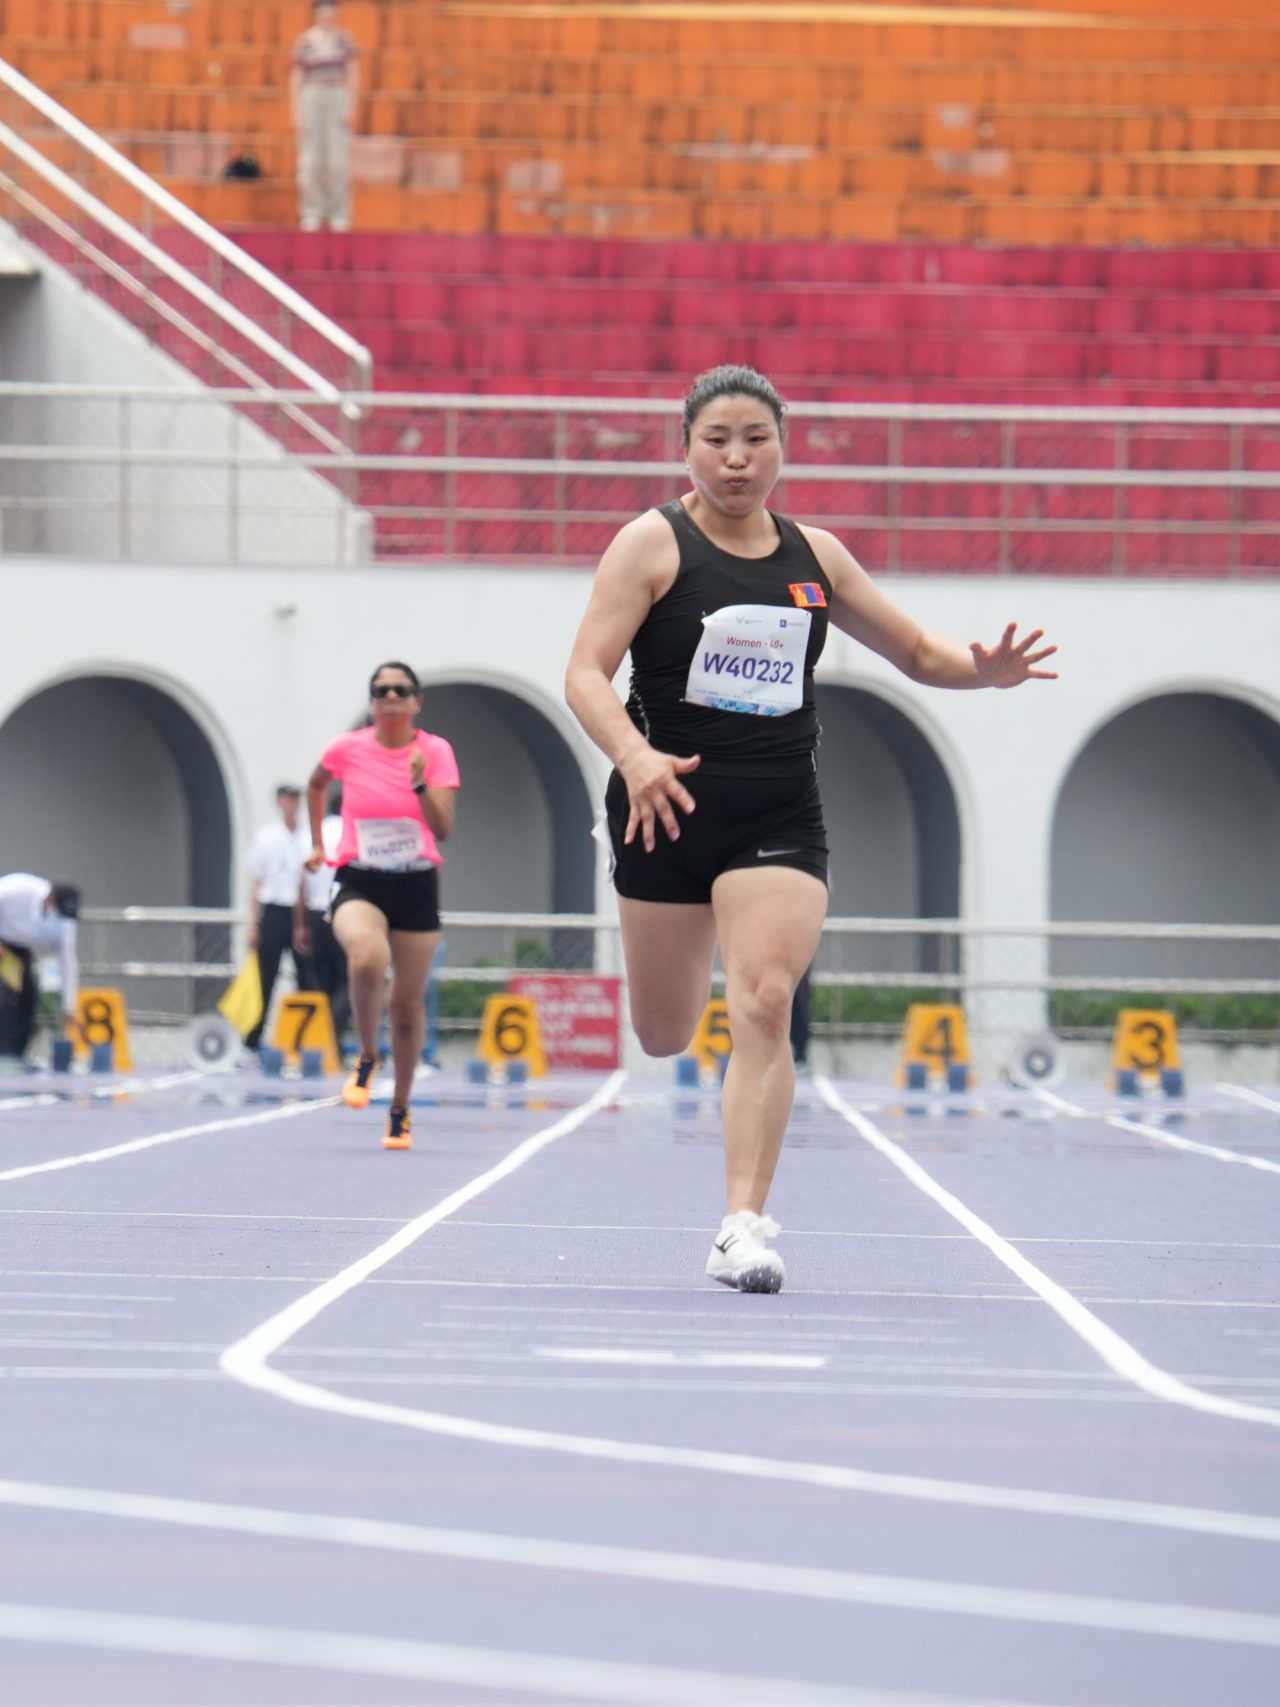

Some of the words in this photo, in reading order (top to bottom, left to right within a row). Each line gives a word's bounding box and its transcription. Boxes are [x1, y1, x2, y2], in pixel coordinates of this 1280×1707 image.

[726, 636, 762, 648] Women
[703, 652, 795, 685] W40232
[82, 999, 115, 1045] 8
[285, 1003, 317, 1051] 7
[494, 1006, 527, 1055] 6
[704, 1011, 734, 1057] 5
[920, 1017, 955, 1065] 4
[1131, 1021, 1166, 1069] 3
